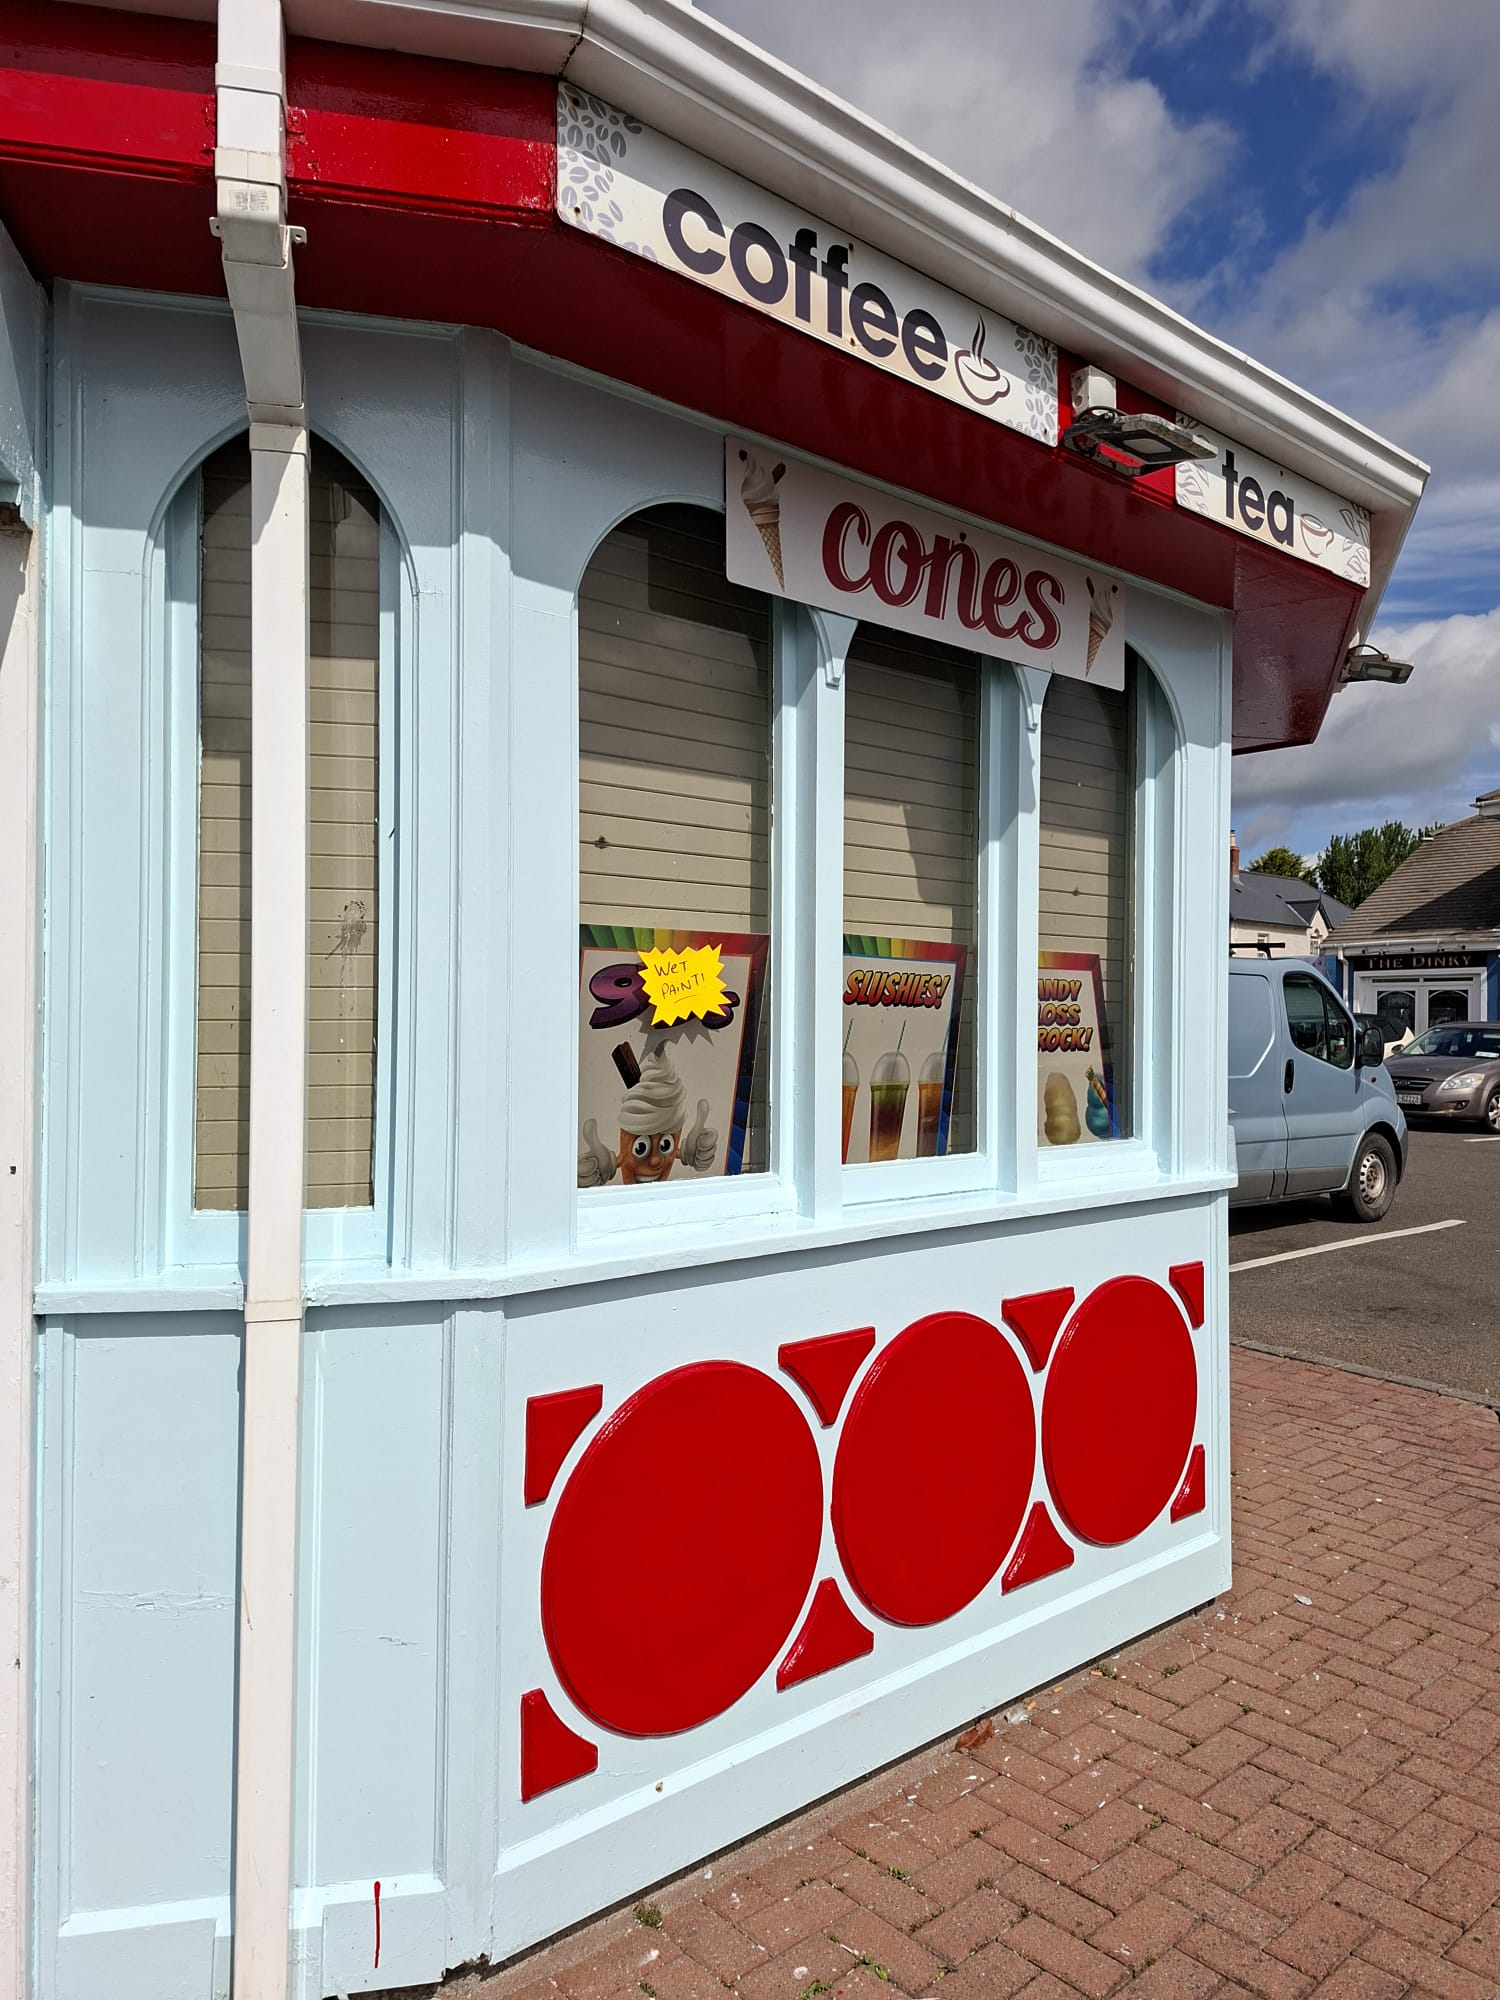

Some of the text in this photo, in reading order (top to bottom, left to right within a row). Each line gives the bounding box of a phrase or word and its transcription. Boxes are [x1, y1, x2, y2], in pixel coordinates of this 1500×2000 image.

[662, 187, 949, 381] coffee
[1222, 448, 1295, 548] tea
[821, 501, 1066, 651] cones
[843, 969, 952, 1010] SLUSHIES!
[1365, 955, 1472, 969] THE DINKY
